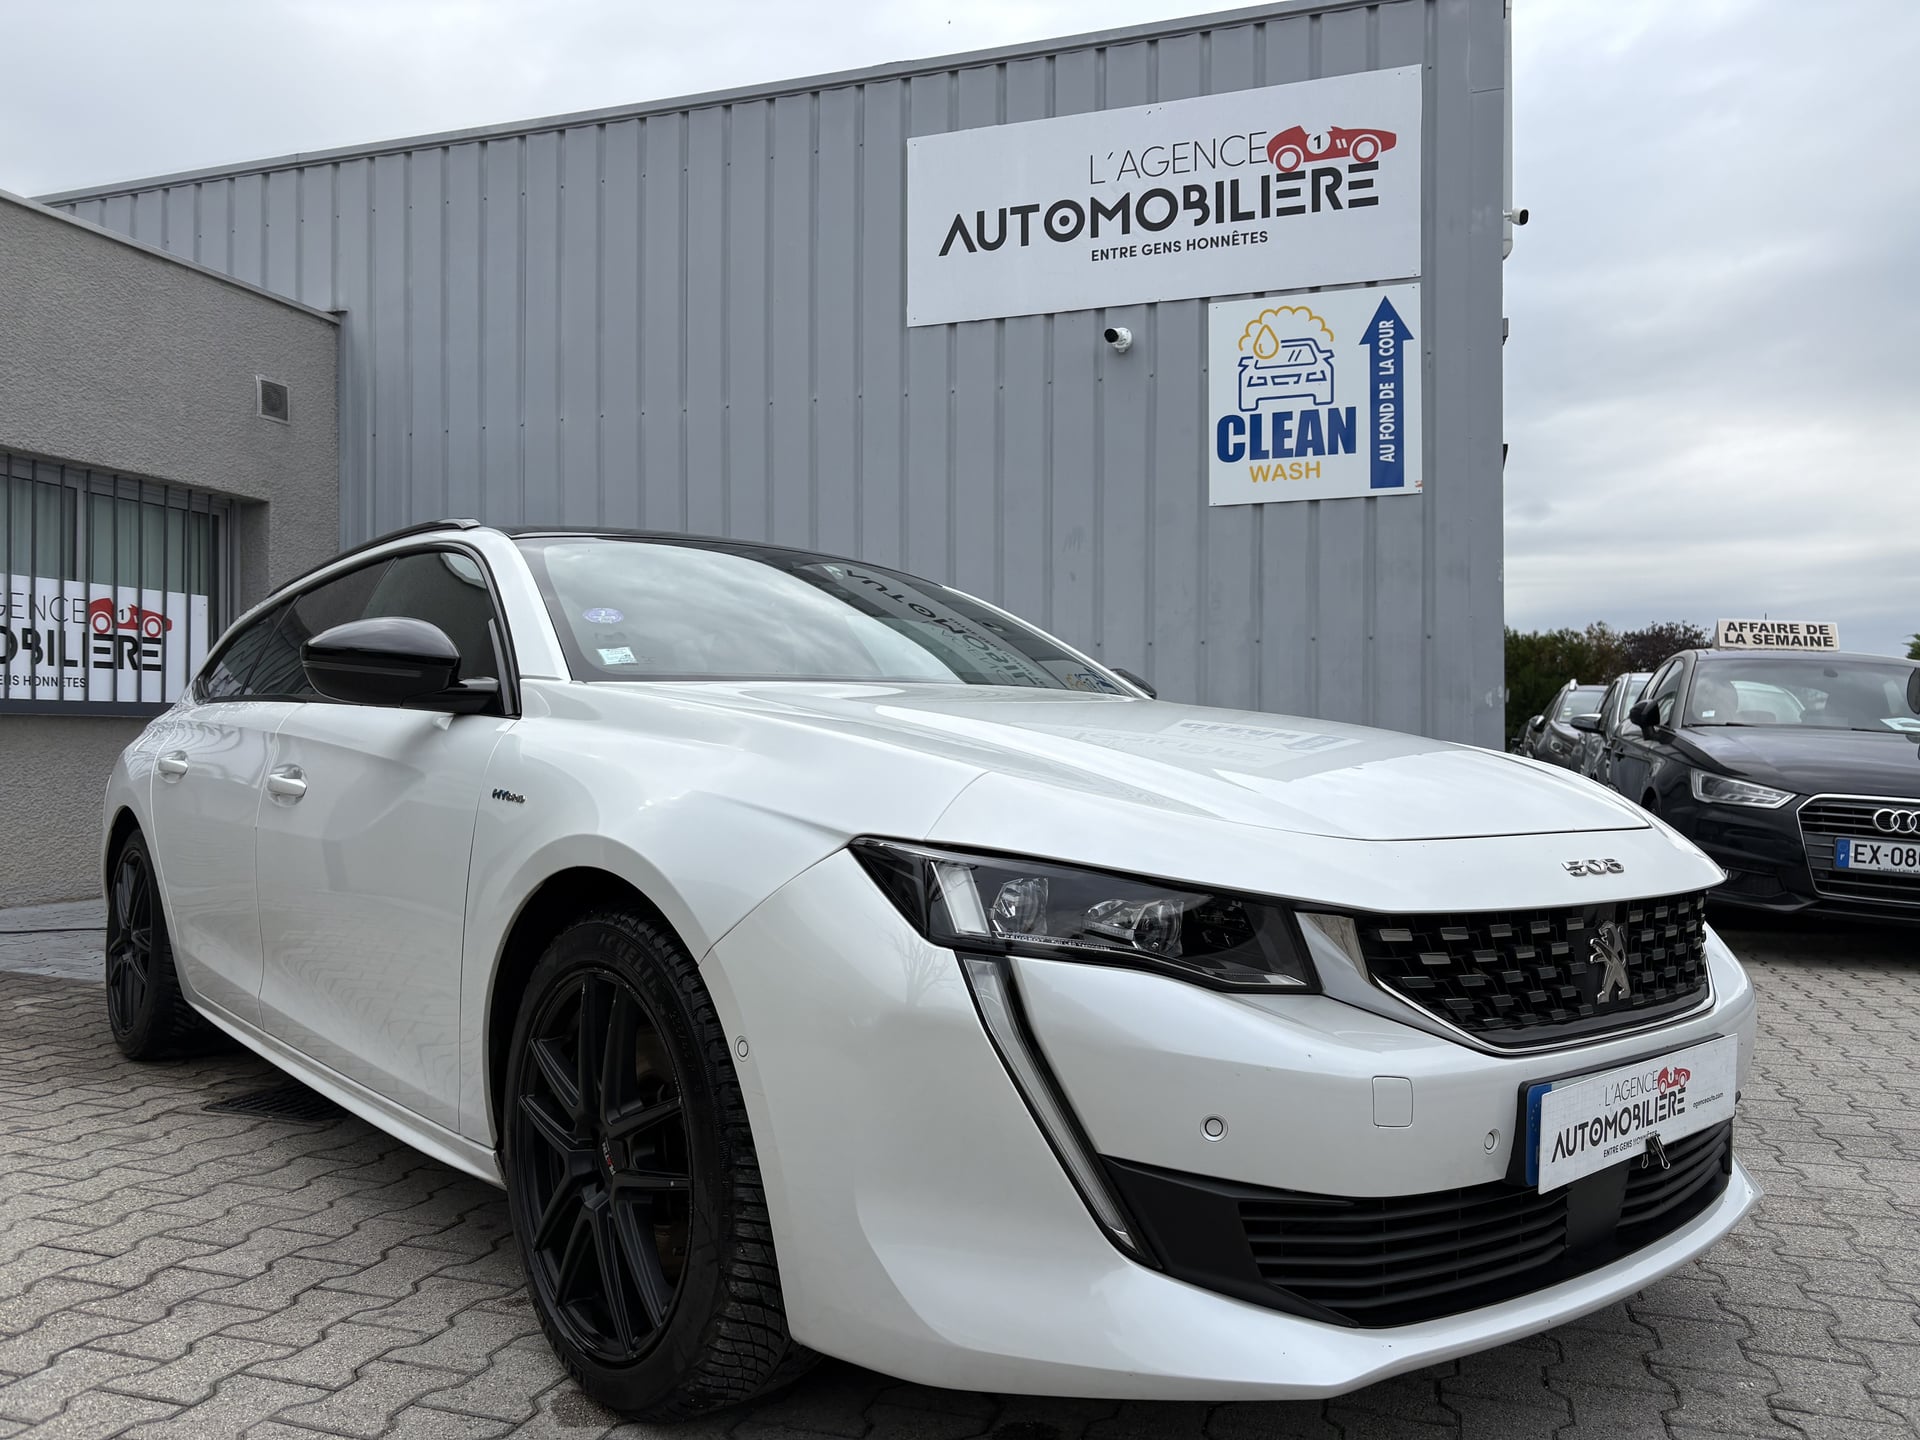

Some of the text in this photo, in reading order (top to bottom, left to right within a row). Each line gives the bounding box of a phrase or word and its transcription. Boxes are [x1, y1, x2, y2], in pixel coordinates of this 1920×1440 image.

[1089, 130, 1268, 184] L'AGENCE
[1091, 230, 1269, 262] ENTRE GENS HONNÊTES
[1378, 319, 1395, 463] AU FOND DE LA COUR
[1216, 406, 1357, 463] CLEAN
[1249, 460, 1321, 483] WASH
[1724, 632, 1835, 648] LA SEMAINE
[1726, 621, 1830, 636] AFFAIRE DE
[1561, 858, 1625, 878] 508
[1853, 843, 1920, 868] EX-08
[1604, 1070, 1659, 1107] L'AGENCE
[1603, 1144, 1619, 1158] ENTRE
[1619, 1139, 1633, 1152] GENS
